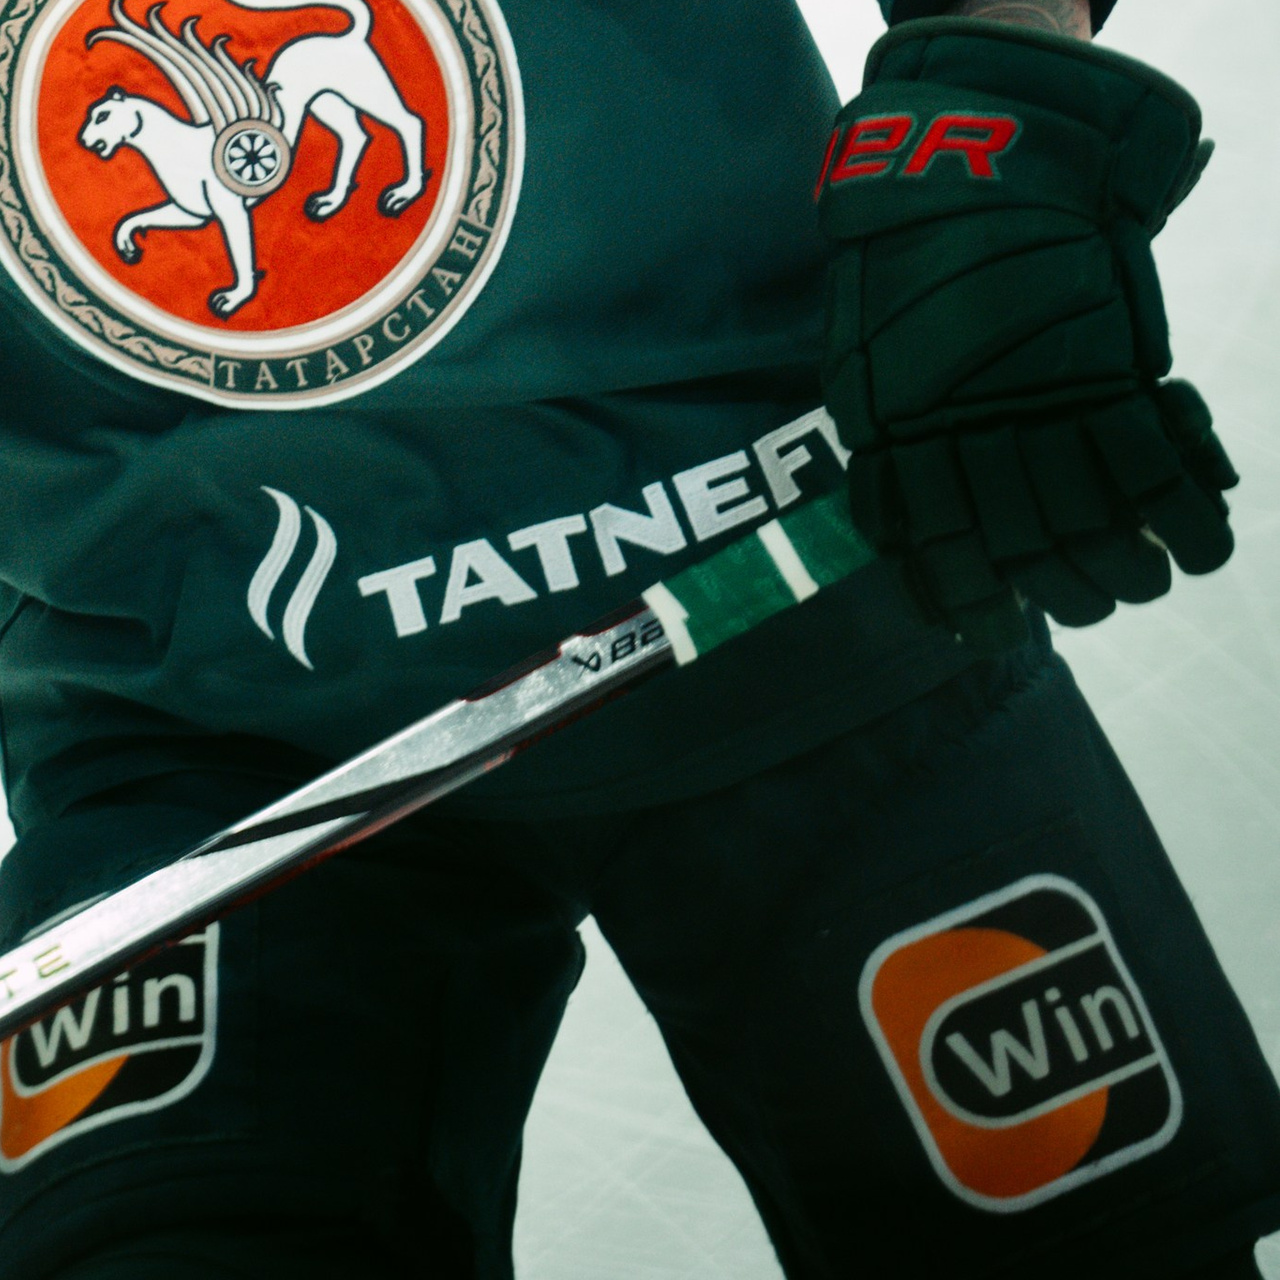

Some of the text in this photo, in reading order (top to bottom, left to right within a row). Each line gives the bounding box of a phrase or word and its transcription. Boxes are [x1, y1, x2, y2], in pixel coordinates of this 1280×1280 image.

[218, 225, 484, 391] ТАТАРСТАН
[30, 971, 196, 1069] Win
[945, 985, 1141, 1098] Win
